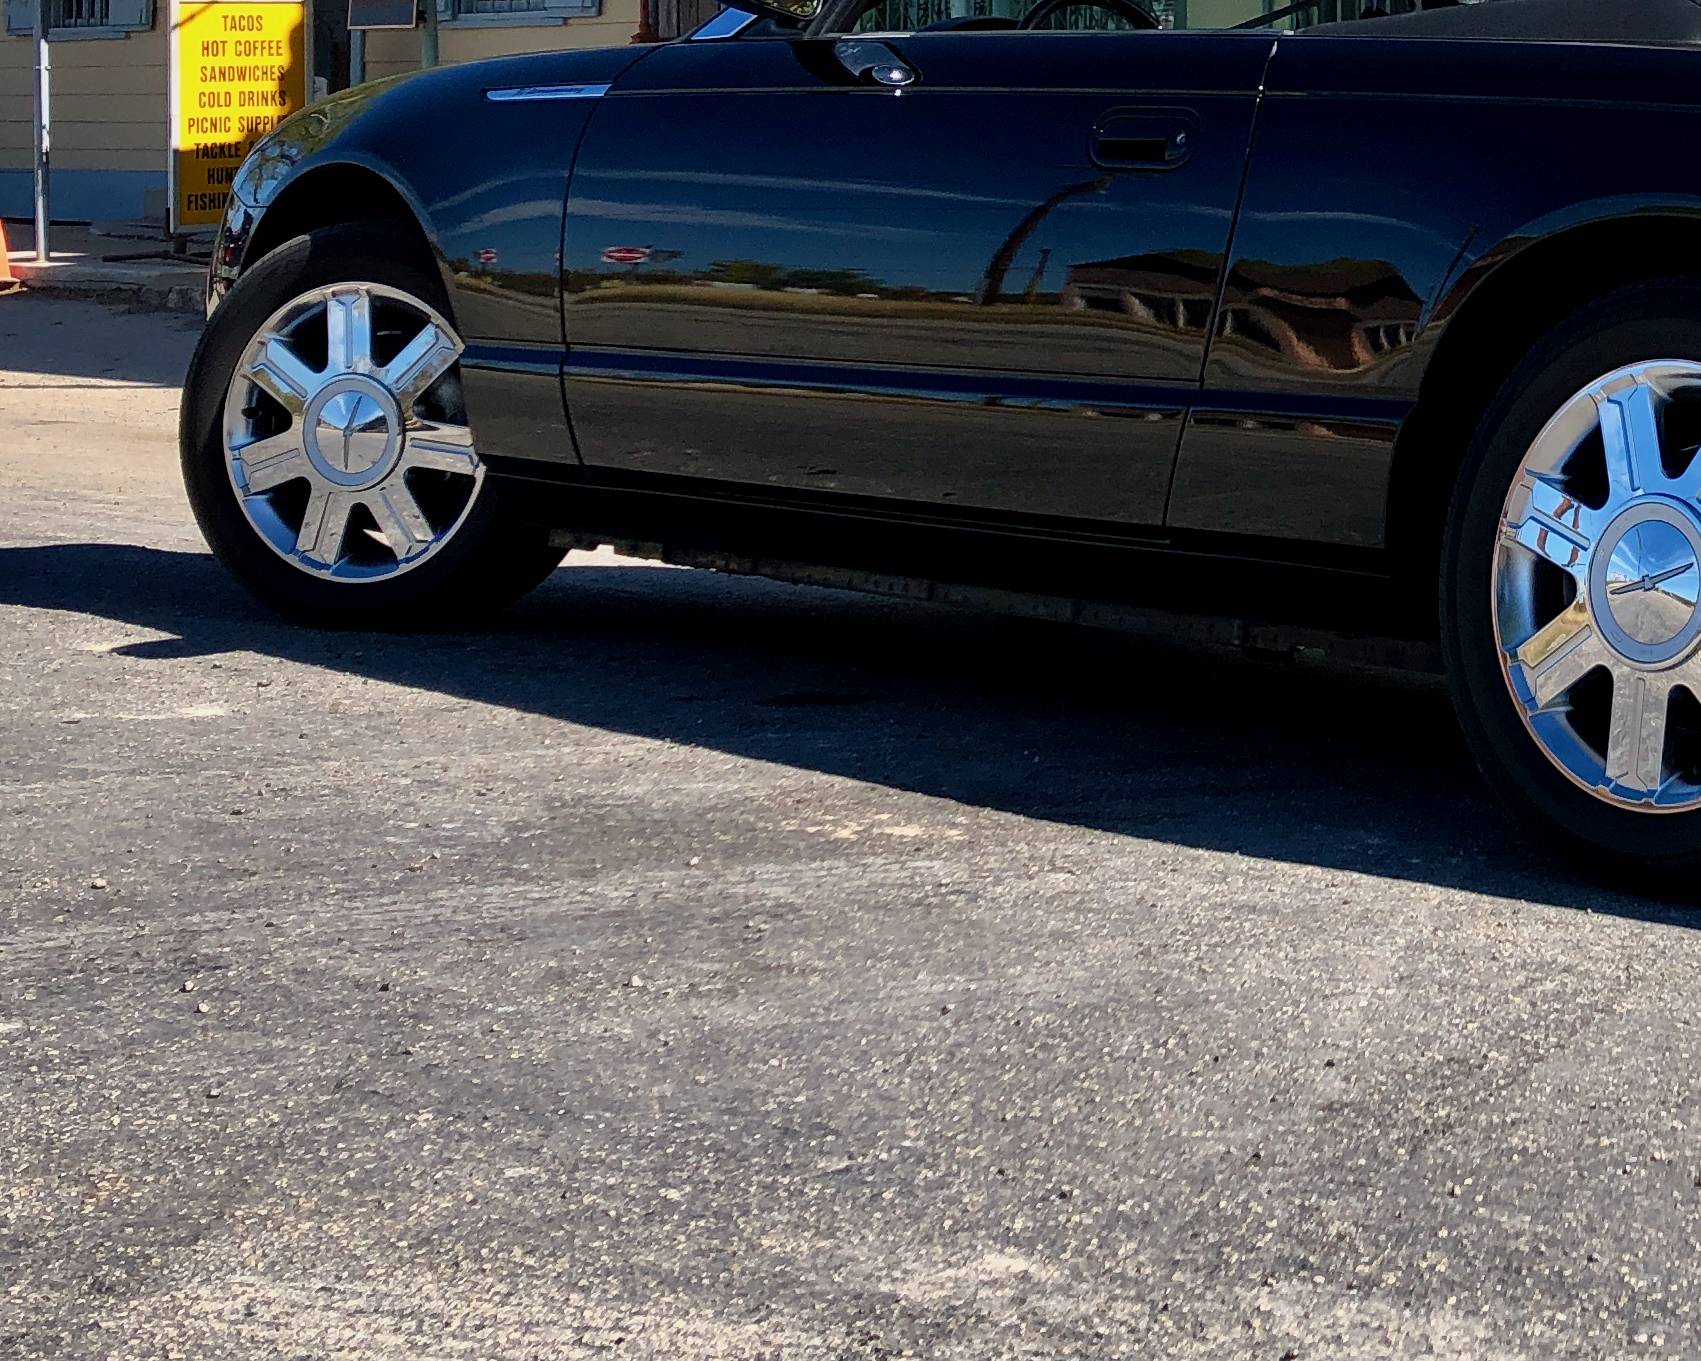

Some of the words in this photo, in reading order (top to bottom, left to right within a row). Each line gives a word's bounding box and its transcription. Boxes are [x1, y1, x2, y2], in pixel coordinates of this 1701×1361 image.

[222, 15, 264, 32] TACOS
[201, 40, 228, 57] HOT
[234, 40, 283, 57] COFFEE
[200, 65, 285, 83] SANDWICHES
[198, 91, 232, 109] COLD
[238, 90, 287, 107] DRINKS
[188, 117, 231, 134] PICNIC
[194, 141, 241, 159] TACKLE
